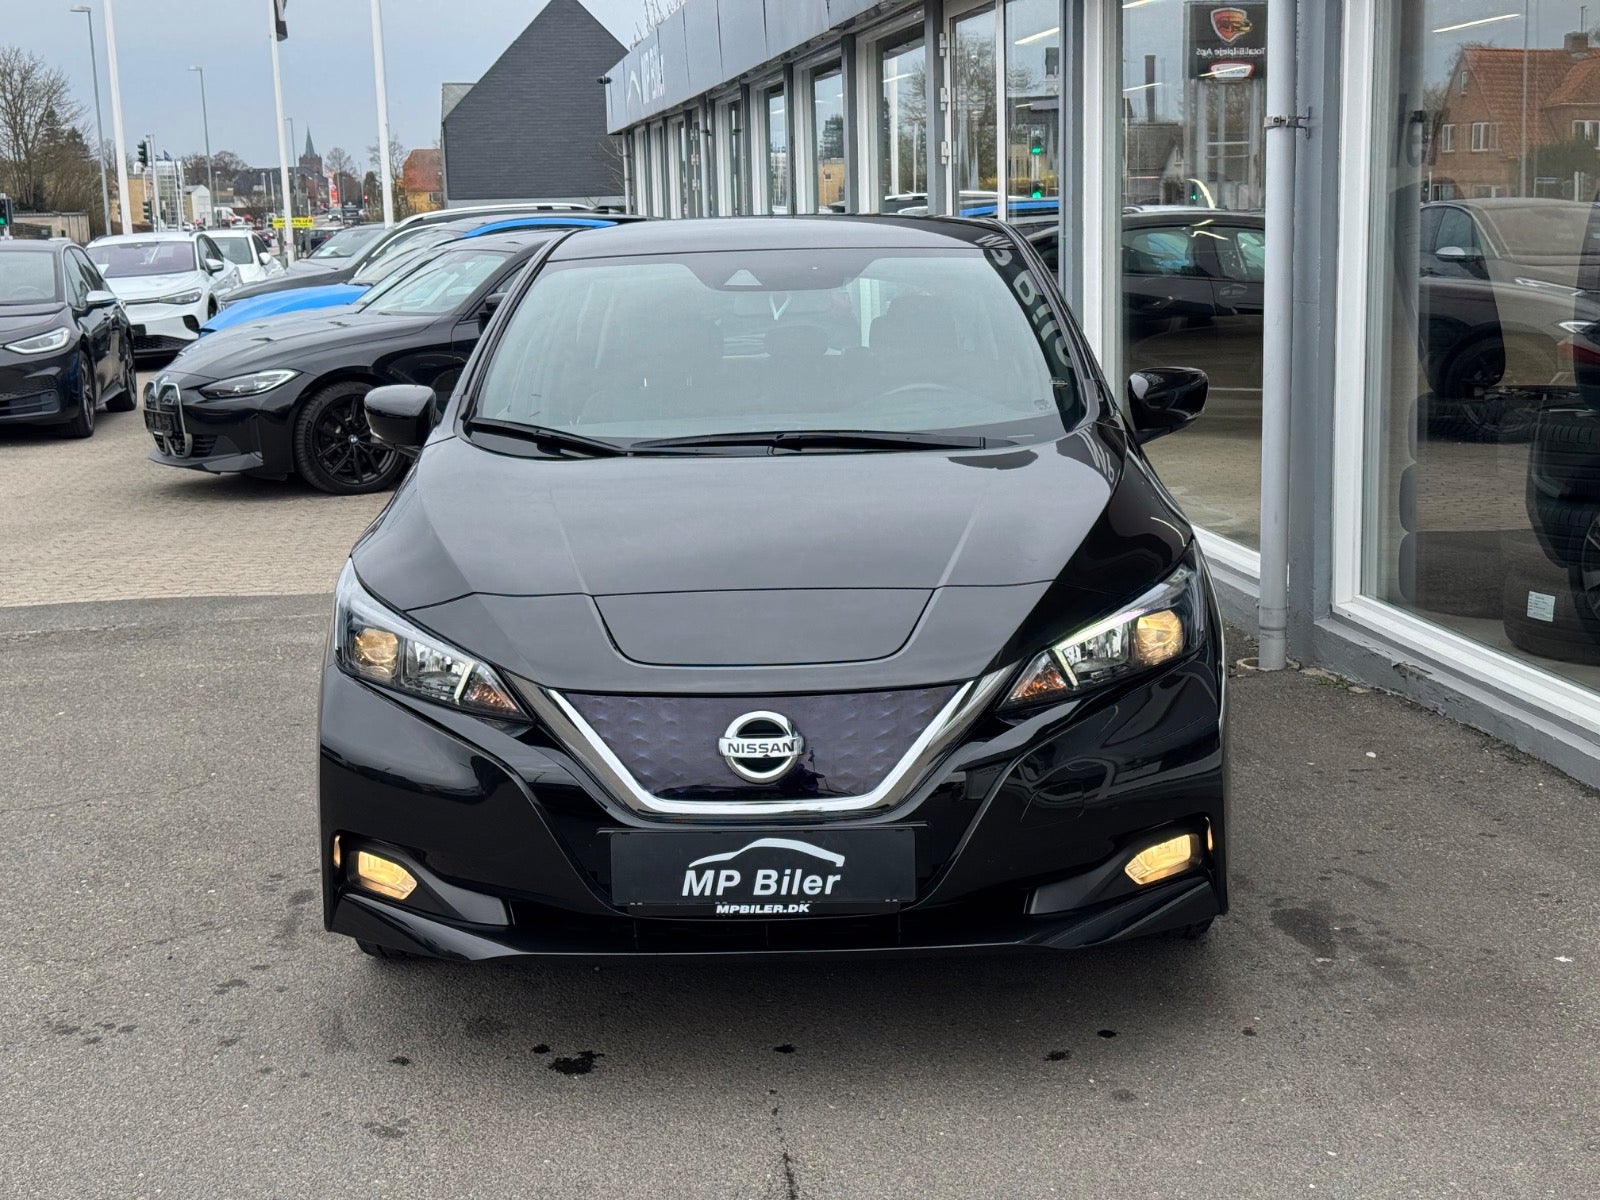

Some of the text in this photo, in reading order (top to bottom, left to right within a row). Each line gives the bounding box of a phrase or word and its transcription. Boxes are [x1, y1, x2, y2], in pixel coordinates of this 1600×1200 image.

[728, 742, 795, 754] NISSAN
[682, 868, 842, 897] MP Biler
[716, 903, 811, 915] MPBILER.DK
